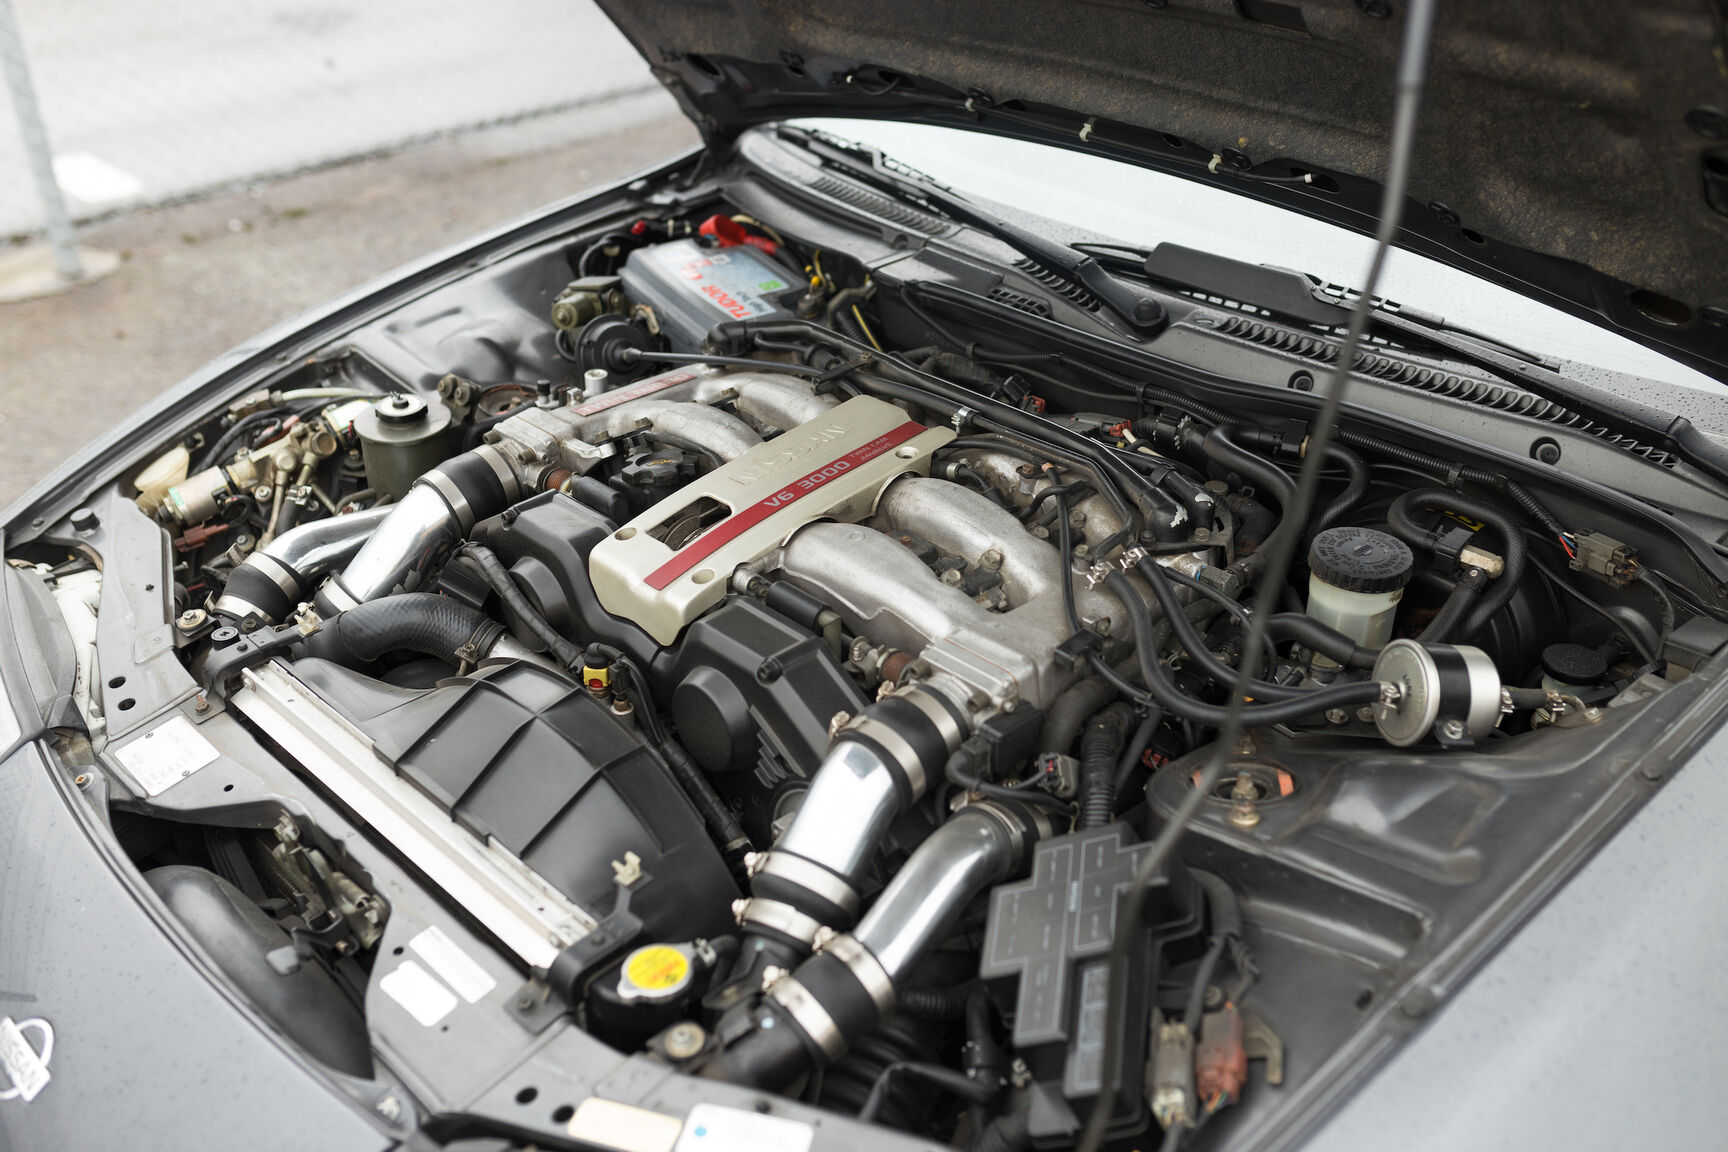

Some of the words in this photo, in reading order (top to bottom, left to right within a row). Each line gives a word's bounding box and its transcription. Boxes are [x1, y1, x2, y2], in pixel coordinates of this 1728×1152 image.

[701, 284, 752, 319] TUDOR
[728, 423, 852, 486] NISSAN
[762, 492, 795, 509] V6
[796, 460, 852, 490] 3000
[848, 446, 870, 459] TWIN
[869, 436, 889, 449] CAM
